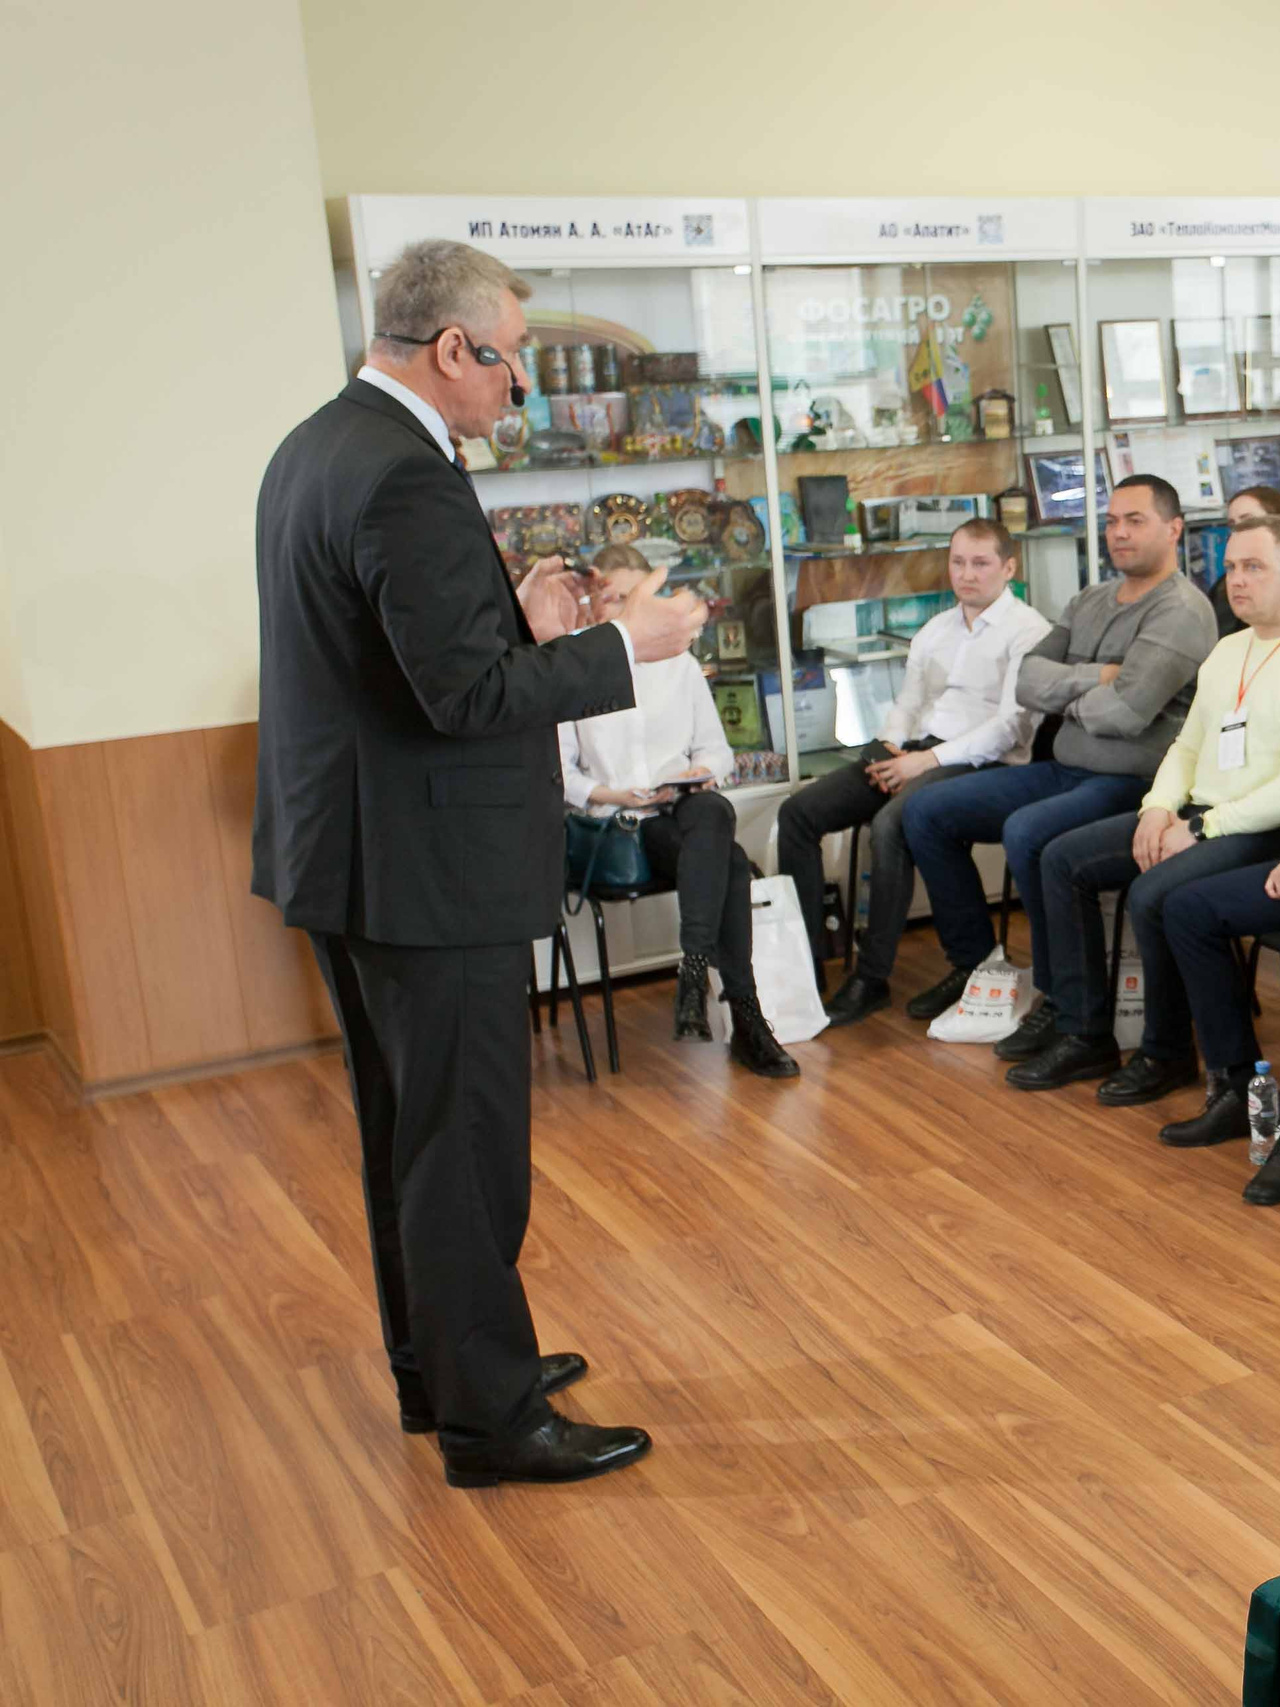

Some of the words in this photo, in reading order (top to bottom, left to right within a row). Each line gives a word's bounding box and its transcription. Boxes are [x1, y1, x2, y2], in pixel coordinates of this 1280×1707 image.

[468, 220, 493, 238] ИП
[500, 221, 563, 239] Атомян
[567, 221, 585, 239] А.
[590, 221, 607, 239] А.
[613, 221, 673, 239] «АтАг»
[878, 223, 898, 238] АО
[903, 223, 969, 239] «Апатит»
[797, 293, 951, 324] ФОСАГРО
